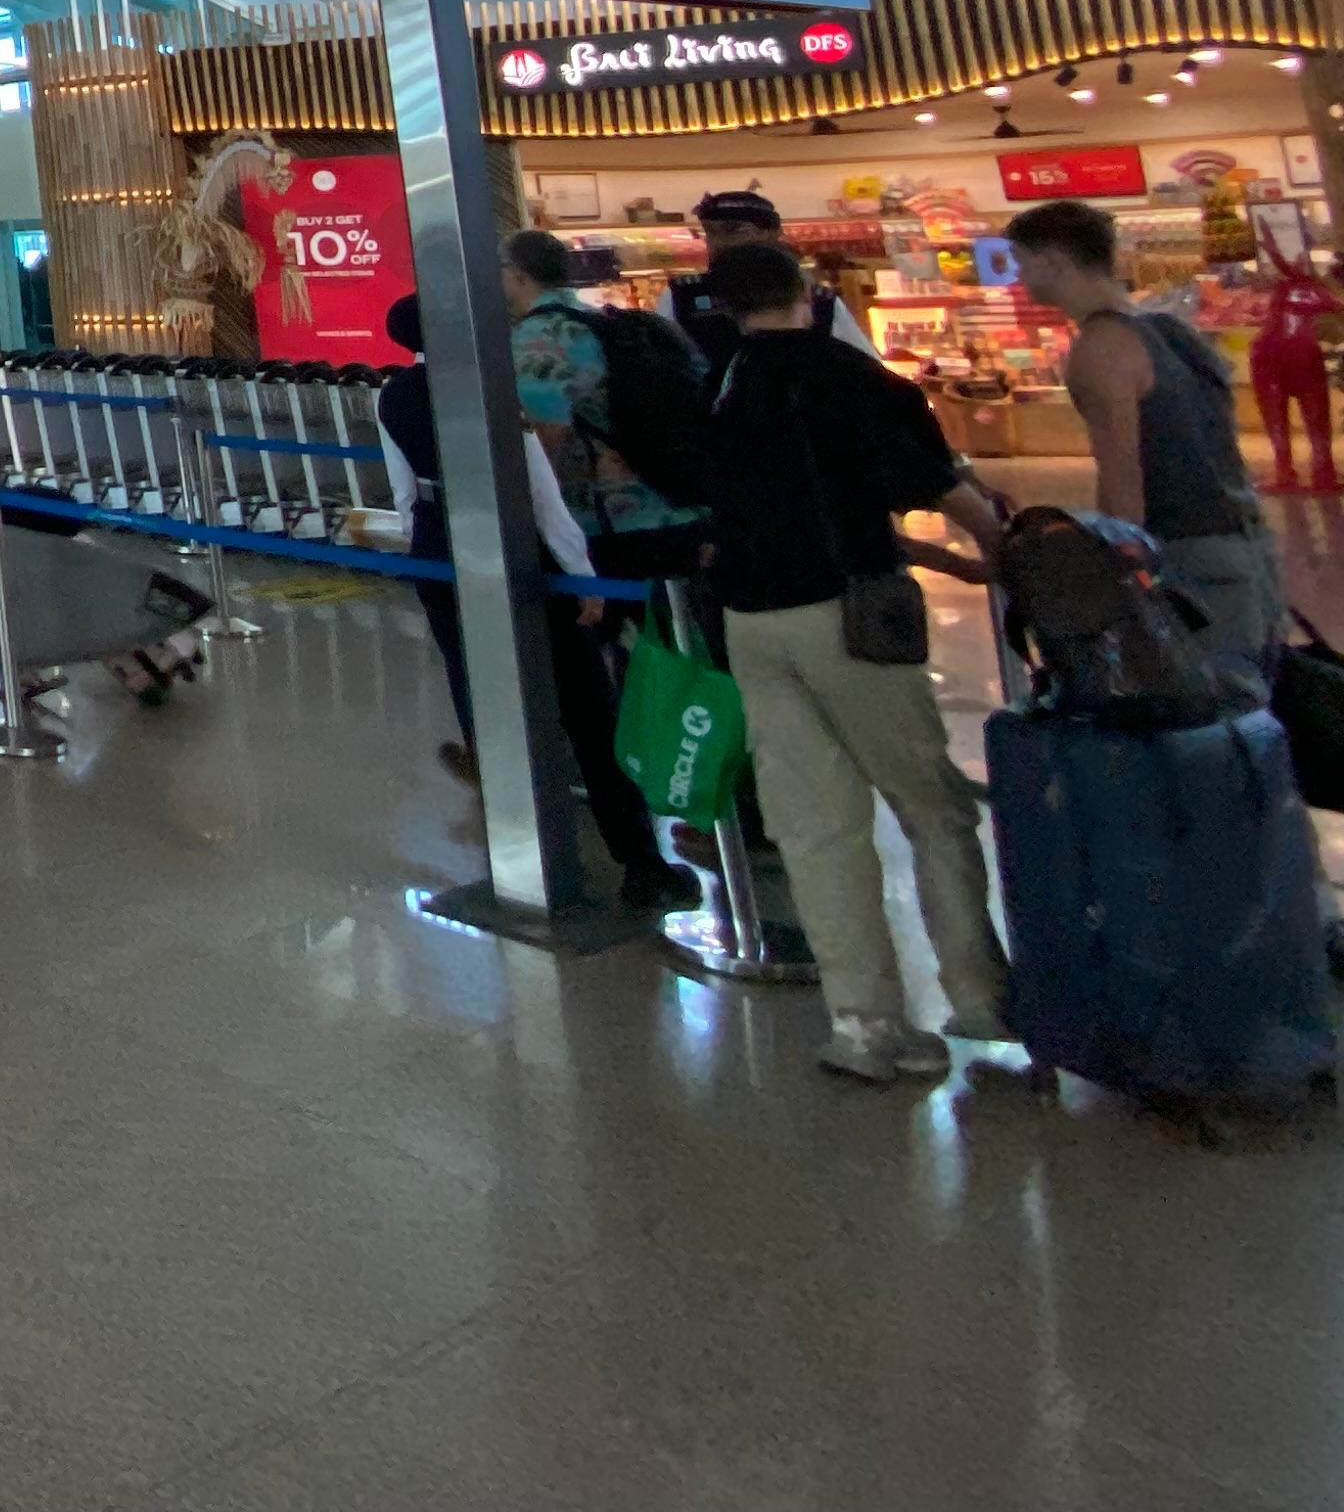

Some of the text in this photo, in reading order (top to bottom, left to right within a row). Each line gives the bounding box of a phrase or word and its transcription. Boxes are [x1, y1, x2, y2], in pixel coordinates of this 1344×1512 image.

[664, 34, 785, 68] Living
[802, 33, 849, 52] DFS
[336, 215, 363, 225] GET
[350, 254, 381, 266] OFF
[667, 737, 699, 809] CIRCLE
